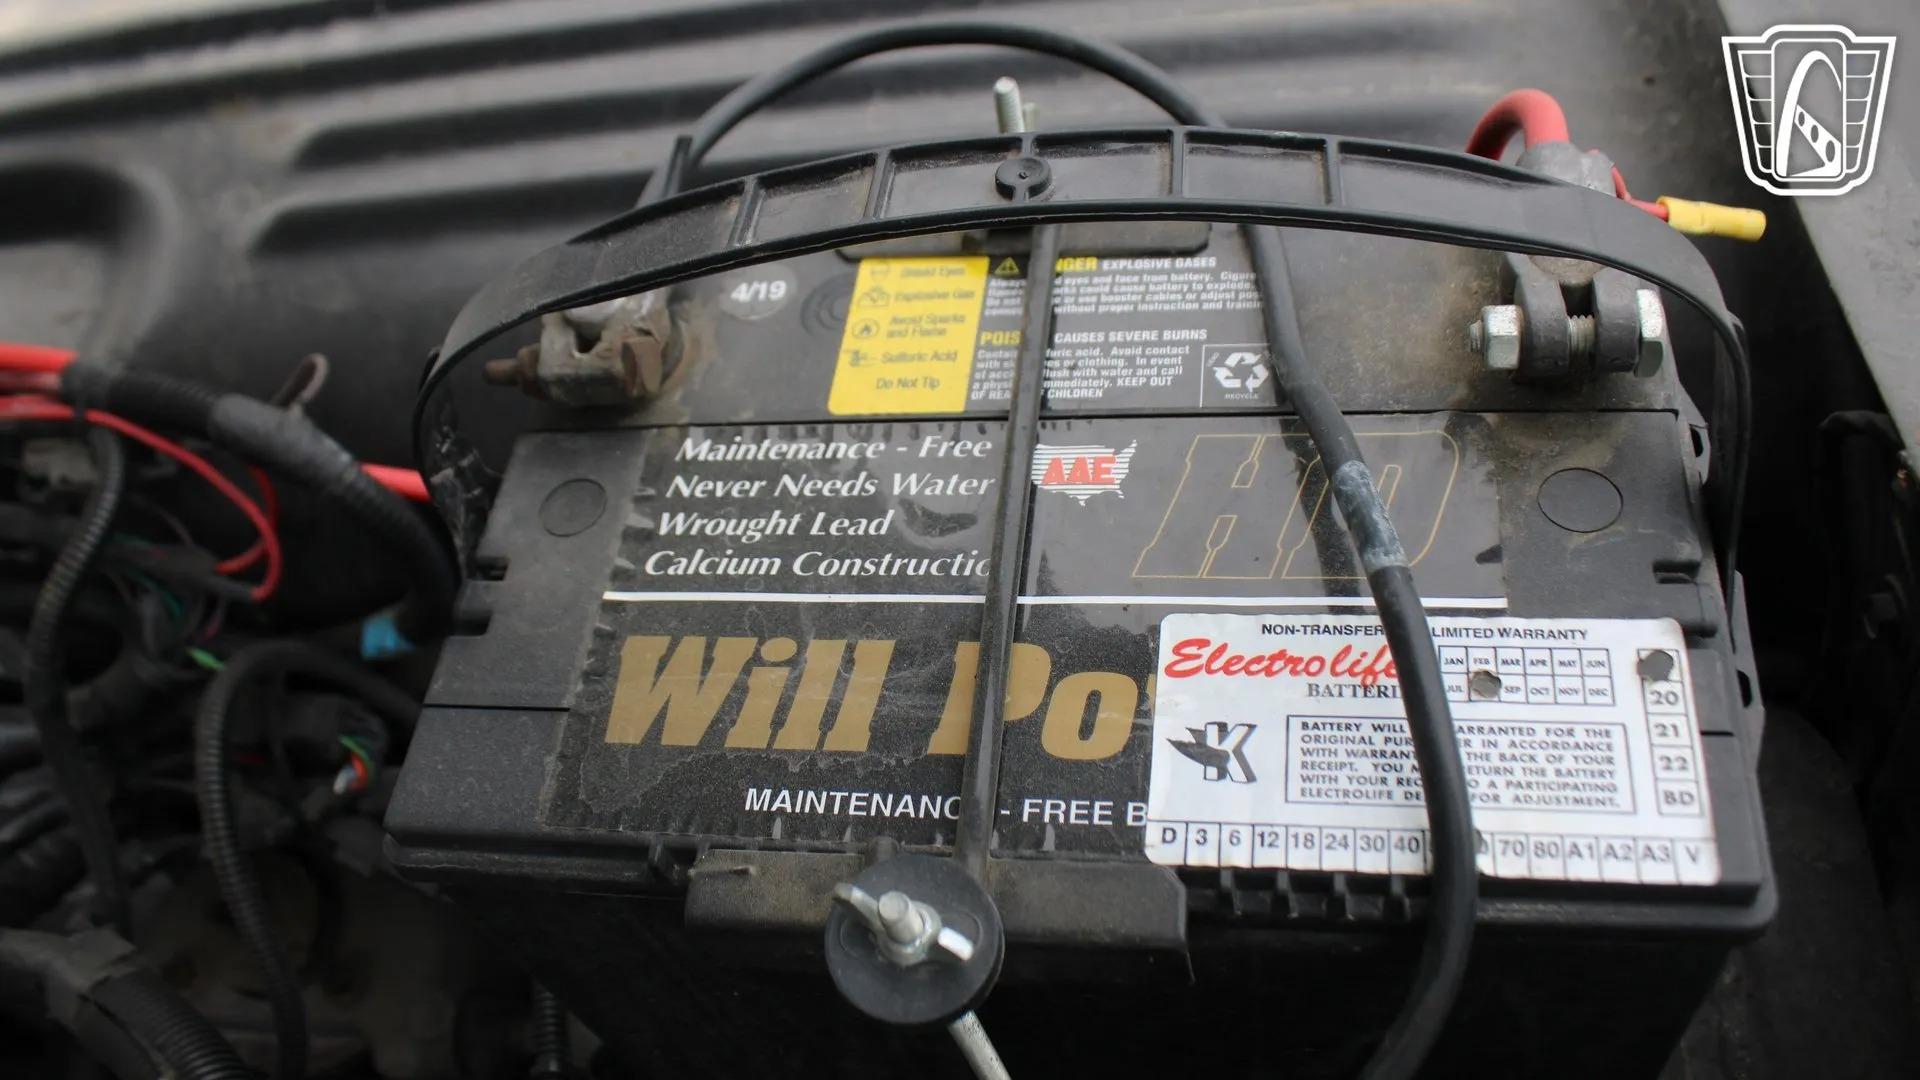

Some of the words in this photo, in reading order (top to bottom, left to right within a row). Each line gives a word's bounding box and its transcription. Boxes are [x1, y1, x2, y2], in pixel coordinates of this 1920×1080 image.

[1056, 257, 1097, 272] NGER
[1103, 257, 1171, 270] EXPLOSIVE
[1175, 256, 1217, 269] GASES
[1091, 275, 1112, 284] and
[1114, 274, 1140, 283] face
[1142, 273, 1168, 283] from
[730, 280, 787, 302] 4/19
[1080, 285, 1110, 294] could
[1113, 284, 1146, 293] cause
[1149, 282, 1189, 292] battery
[1192, 281, 1203, 290] to
[1100, 293, 1142, 303] booster
[1145, 292, 1183, 301] cables
[1185, 292, 1198, 300] or
[1200, 290, 1235, 301] adjust
[1054, 304, 1095, 313] without
[1098, 304, 1134, 314] proper
[1136, 302, 1200, 312] instruction
[1201, 301, 1223, 310] and
[980, 330, 1021, 346] POIS
[1054, 331, 1105, 343] CAUSES
[1109, 330, 1159, 342] SEVERE
[1163, 328, 1208, 341] BURNS
[931, 349, 958, 361] Acid
[1045, 347, 1072, 358] furic
[1075, 346, 1103, 357] acid.
[1111, 345, 1142, 356] Avoid
[1145, 344, 1189, 355] contact
[976, 359, 1000, 369] with
[1063, 360, 1075, 368] or
[1078, 357, 1128, 368] clothing.
[1136, 356, 1147, 365] In
[1150, 356, 1182, 365] event
[1072, 367, 1097, 377] with
[1101, 367, 1133, 376] water
[1136, 366, 1157, 375] and
[1161, 365, 1183, 375] call
[876, 377, 893, 389] Do
[897, 376, 918, 388] Not
[923, 375, 940, 390] Tip
[1043, 378, 1113, 388] mmediately.
[1117, 376, 1147, 387] KEEP
[1150, 376, 1173, 386] OUT
[971, 390, 986, 400] OF
[988, 390, 1011, 399] REA
[1047, 388, 1103, 399] CHILDREN
[675, 437, 885, 462] Maintenance
[918, 435, 992, 458] Free
[1042, 449, 1115, 485] AAE
[666, 474, 767, 498] Never
[773, 471, 879, 497] Needs
[892, 472, 995, 496] Water
[658, 511, 802, 543] Wrought
[810, 509, 895, 537] Lead
[644, 548, 782, 576] Calcium
[792, 549, 991, 577] Constructio
[1262, 623, 1384, 636] NON-TRANSFER
[1432, 627, 1493, 639] LIMITED
[1497, 628, 1587, 640] WARRANTY
[1164, 638, 1398, 688] Electrolife
[1443, 657, 1464, 666] JAN
[1473, 657, 1491, 666] FEB
[1500, 658, 1521, 667] MAR
[1529, 658, 1549, 667] APR
[1558, 659, 1577, 668] MAY
[1585, 659, 1606, 669] JUN
[604, 635, 896, 752] Will
[927, 641, 1152, 761] Po
[1307, 683, 1401, 699] BATTERI
[1446, 684, 1464, 694] JUL
[1504, 685, 1521, 694] SEP
[1530, 686, 1550, 696] OCT
[1558, 687, 1580, 696] NOV
[1588, 687, 1608, 697] DEC
[1650, 690, 1678, 706] 20
[1301, 721, 1362, 732] BATTERY
[1371, 723, 1406, 733] WILL
[1456, 725, 1536, 736] ARRANTED
[1545, 727, 1576, 738] FOR
[1584, 728, 1612, 739] THE
[1654, 723, 1680, 738] 21
[1301, 734, 1375, 746] ORIGINAL
[1481, 738, 1498, 749] IN
[1508, 739, 1613, 752] ACCORDANCE
[1300, 747, 1338, 758] WITH
[1465, 751, 1491, 762] THE
[1499, 752, 1538, 764] BACK
[1545, 754, 1565, 765] OF
[1573, 755, 1614, 766] YOUR
[1658, 756, 1689, 772] 22
[1301, 760, 1358, 772] RECEIPT.
[1372, 762, 1404, 773] YOU
[1467, 765, 1514, 776] ETURN
[1521, 766, 1546, 777] THE
[1554, 767, 1616, 779] BATTERY
[1300, 774, 1338, 785] WITH
[1346, 775, 1388, 786] YOUR
[1466, 779, 1479, 789] O
[1487, 780, 1498, 790] A
[1505, 780, 1618, 793] PARTICIPATING
[1300, 787, 1393, 800] ELECTROLIFE
[1513, 793, 1619, 808] ADJUSTMENT.
[1664, 790, 1695, 806] BD
[745, 787, 961, 820] MAINTENANC
[1022, 798, 1113, 826] FREE
[1162, 828, 1176, 844] D
[1195, 828, 1208, 845] 3
[1229, 830, 1241, 846] 6
[1257, 831, 1279, 848] 12
[1291, 832, 1315, 850] 18
[1325, 834, 1349, 851] 24
[1359, 835, 1385, 852] 30
[1394, 836, 1420, 853] 40
[1499, 840, 1525, 857] 70
[1534, 841, 1560, 859] 80
[1567, 842, 1594, 860] A1
[1603, 843, 1633, 862] A2
[1641, 844, 1670, 863] A3
[1684, 846, 1700, 864] V
